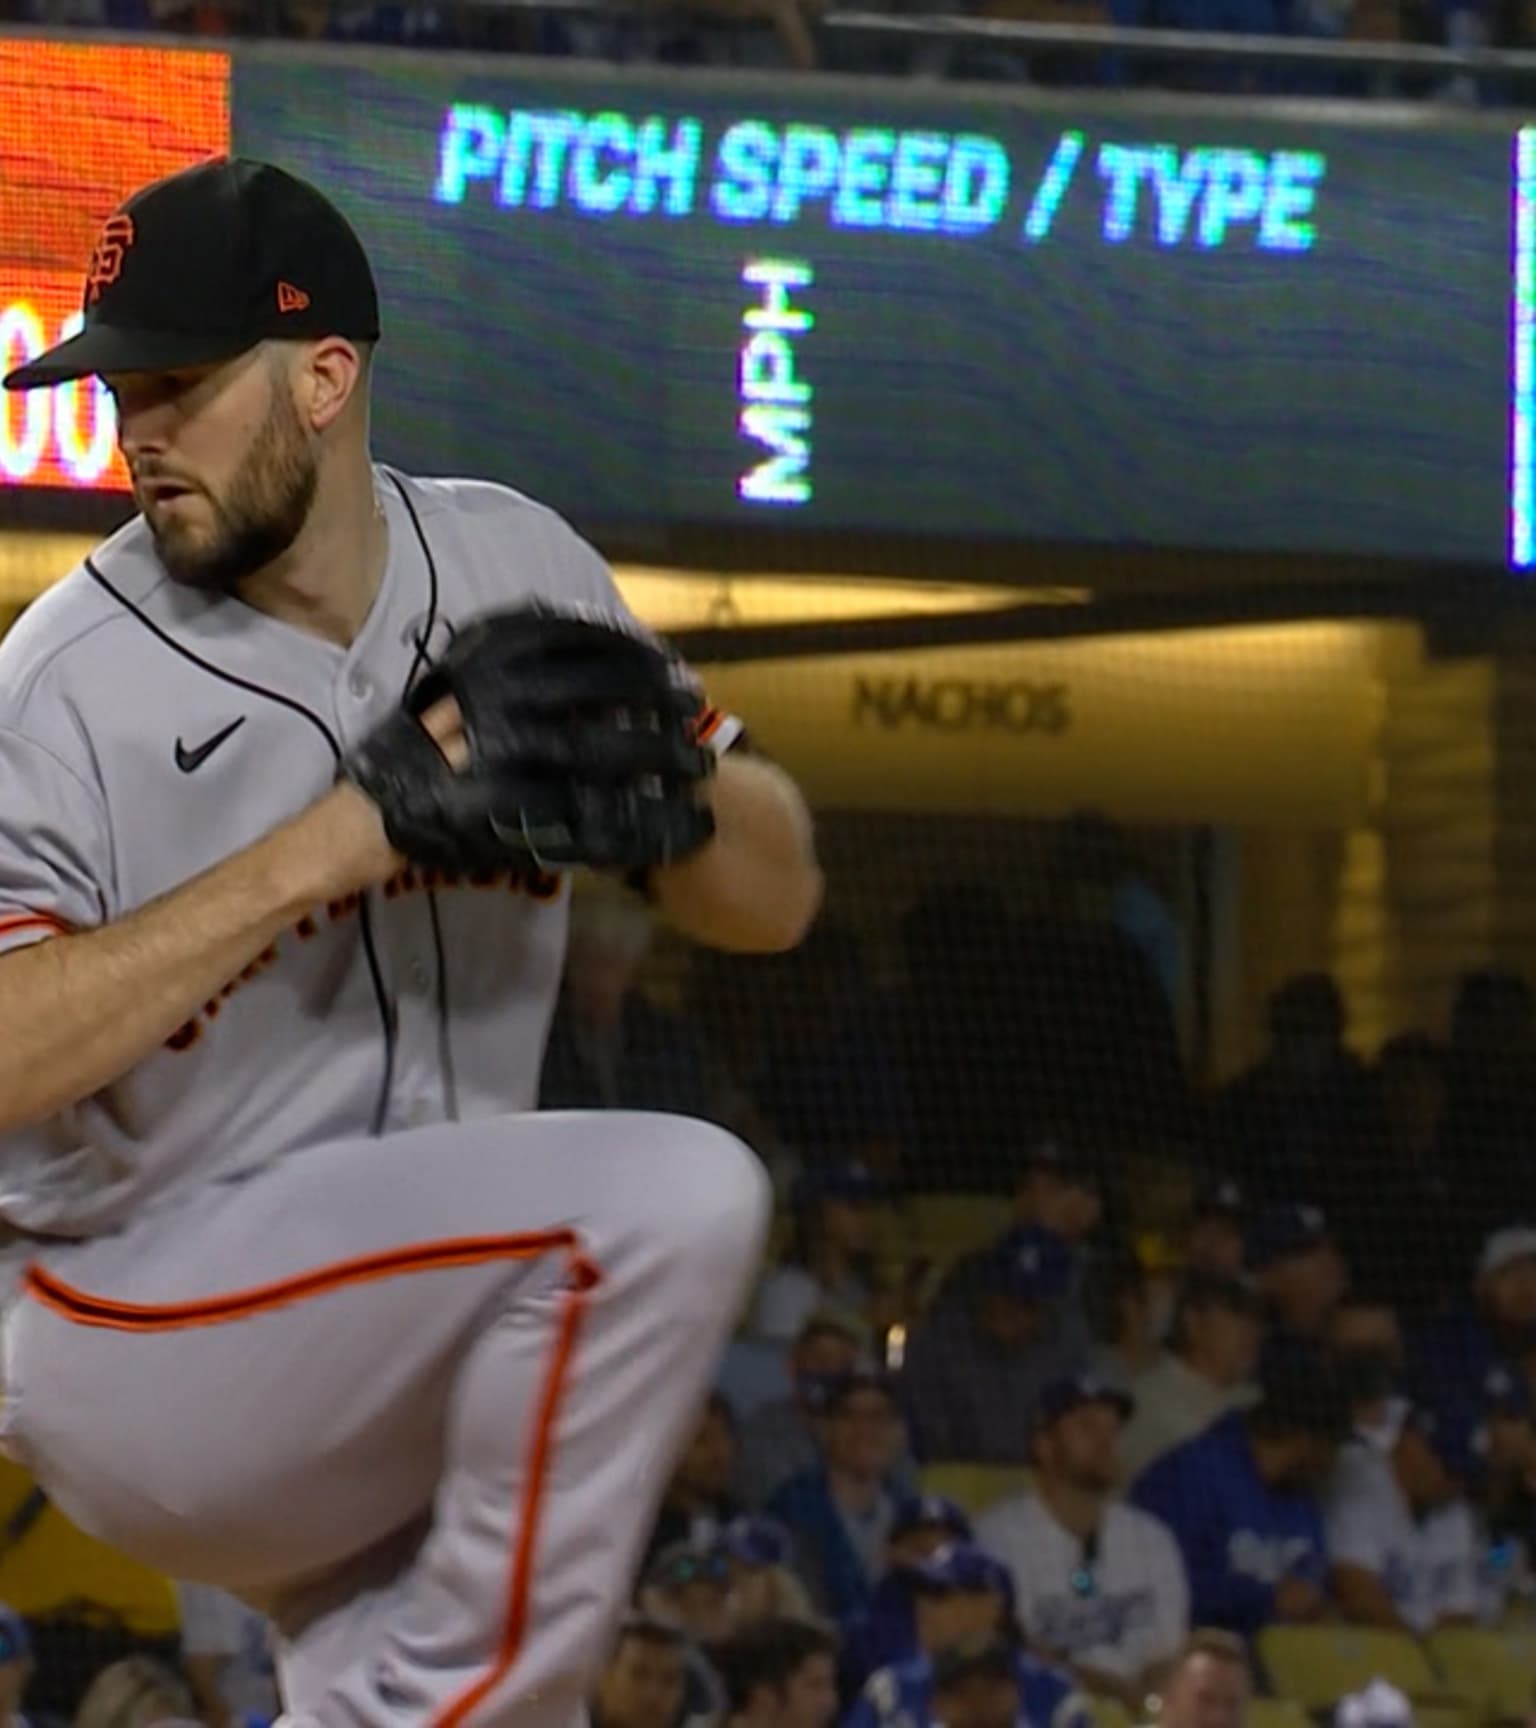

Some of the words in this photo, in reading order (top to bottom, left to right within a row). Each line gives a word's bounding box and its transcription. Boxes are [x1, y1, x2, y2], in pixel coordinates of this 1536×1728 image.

[435, 102, 704, 217] PITCH
[710, 120, 1012, 236] SPEED
[1097, 143, 1328, 254] TYPE
[738, 258, 814, 504] MPH
[850, 675, 1072, 736] NACHOS
